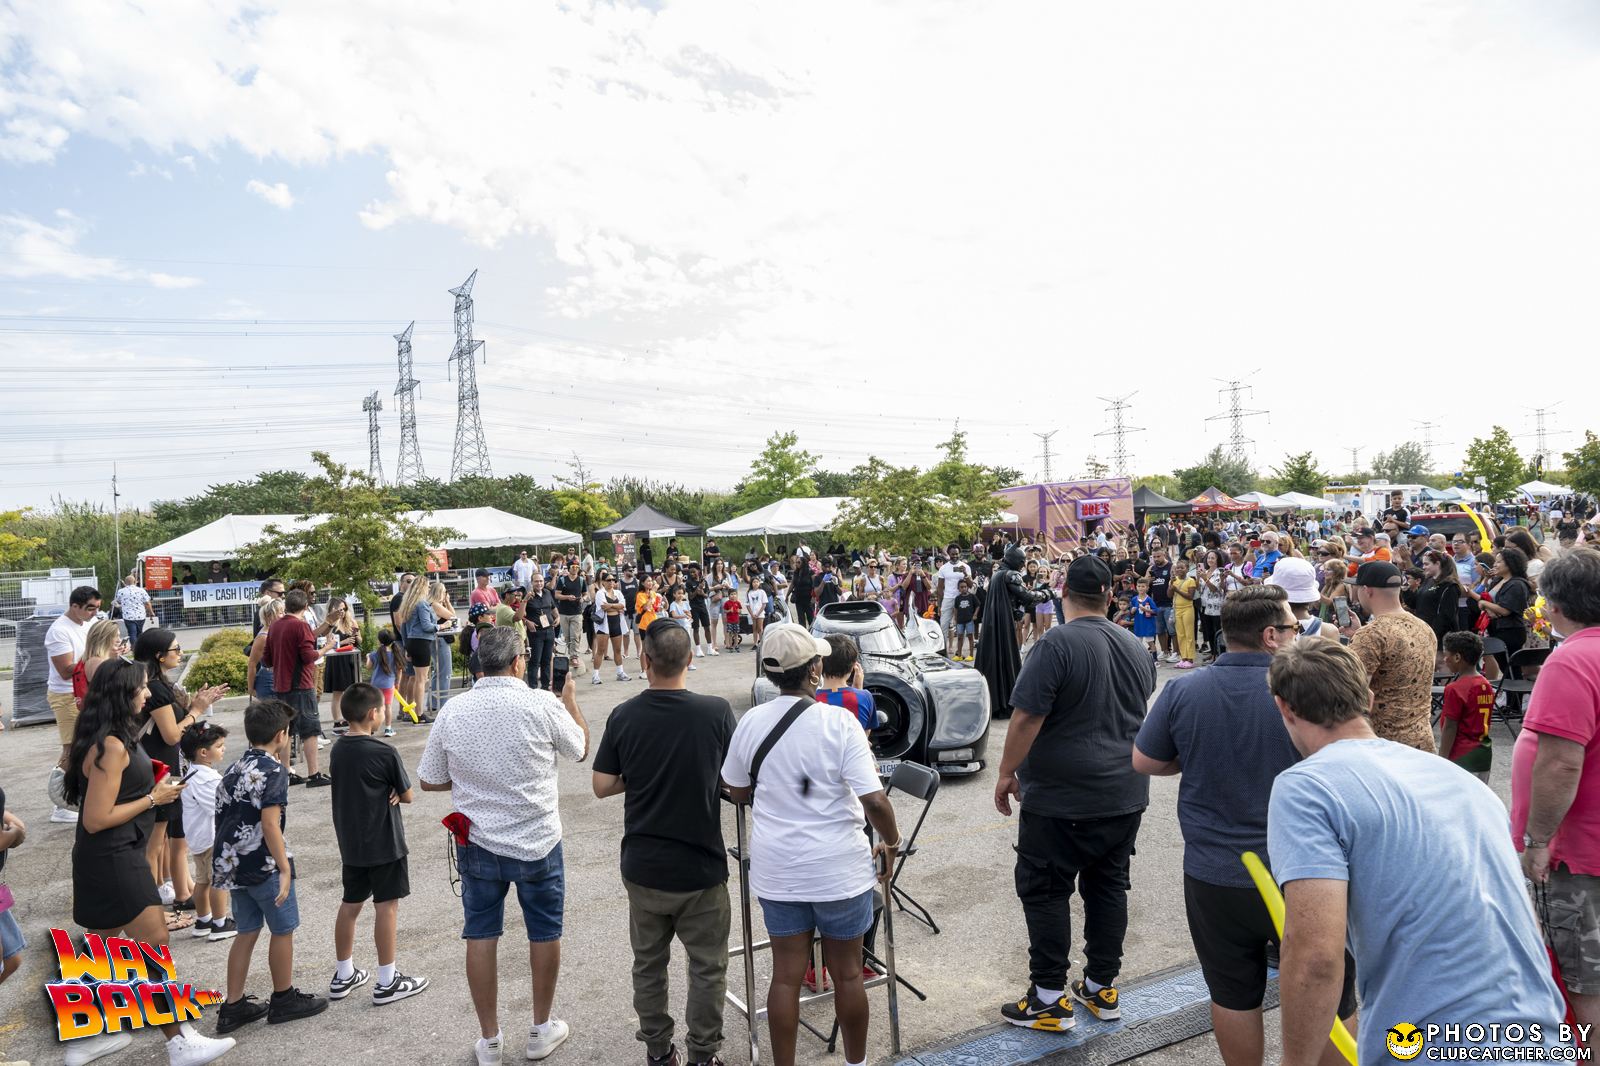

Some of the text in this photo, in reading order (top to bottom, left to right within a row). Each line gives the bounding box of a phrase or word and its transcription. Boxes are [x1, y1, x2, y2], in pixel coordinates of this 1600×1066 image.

[190, 589, 207, 602] BAR
[215, 588, 237, 600] CASH
[243, 586, 261, 602] CRE
[1479, 708, 1489, 736] 7
